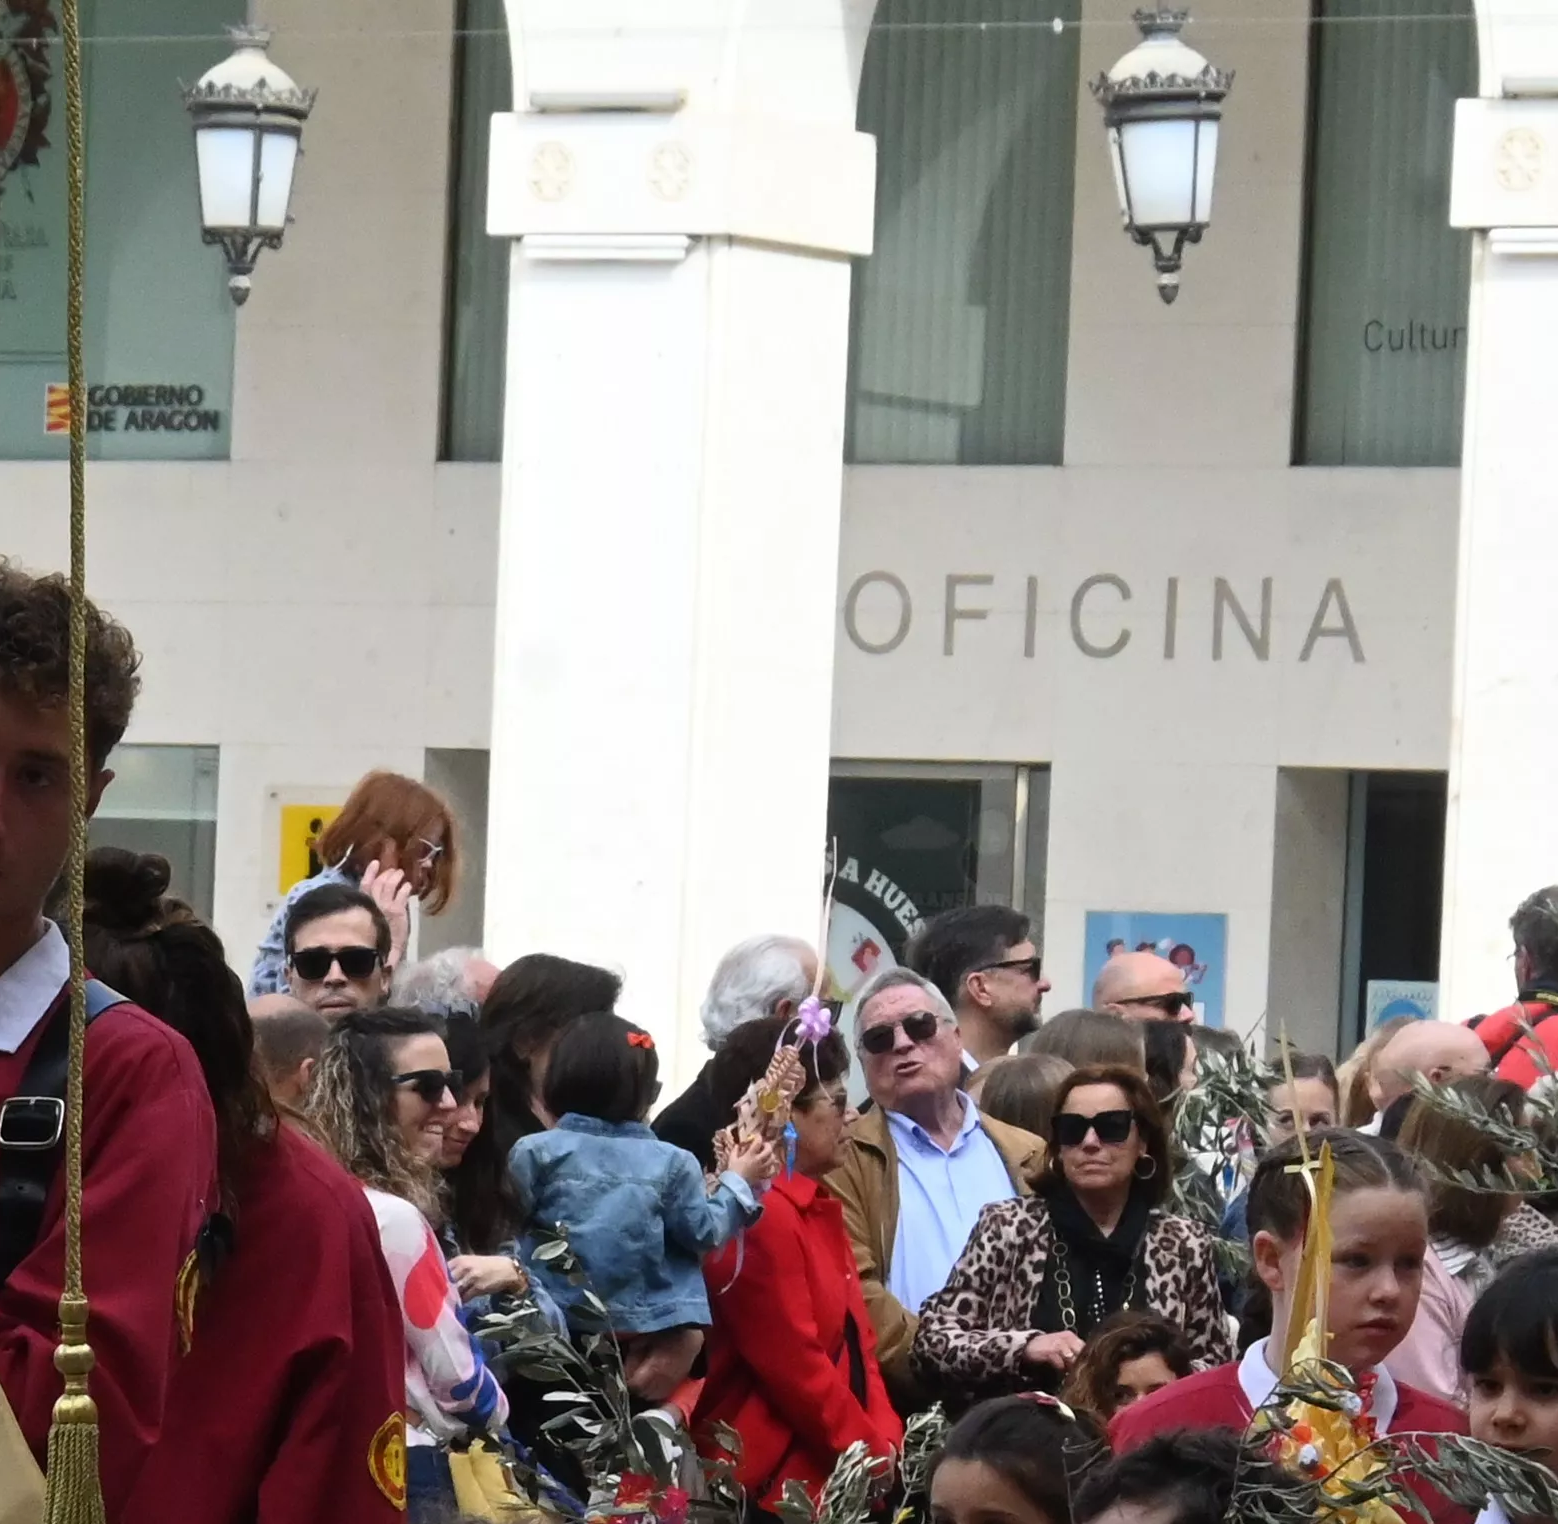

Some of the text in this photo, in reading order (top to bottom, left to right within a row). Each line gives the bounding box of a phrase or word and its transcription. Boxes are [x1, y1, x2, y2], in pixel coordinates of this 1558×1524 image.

[1364, 319, 1467, 353] Cultur
[88, 384, 204, 407] GOBIERNO
[87, 410, 116, 432] DE
[843, 570, 1367, 664] OFICINA
[863, 868, 927, 940] HUES
